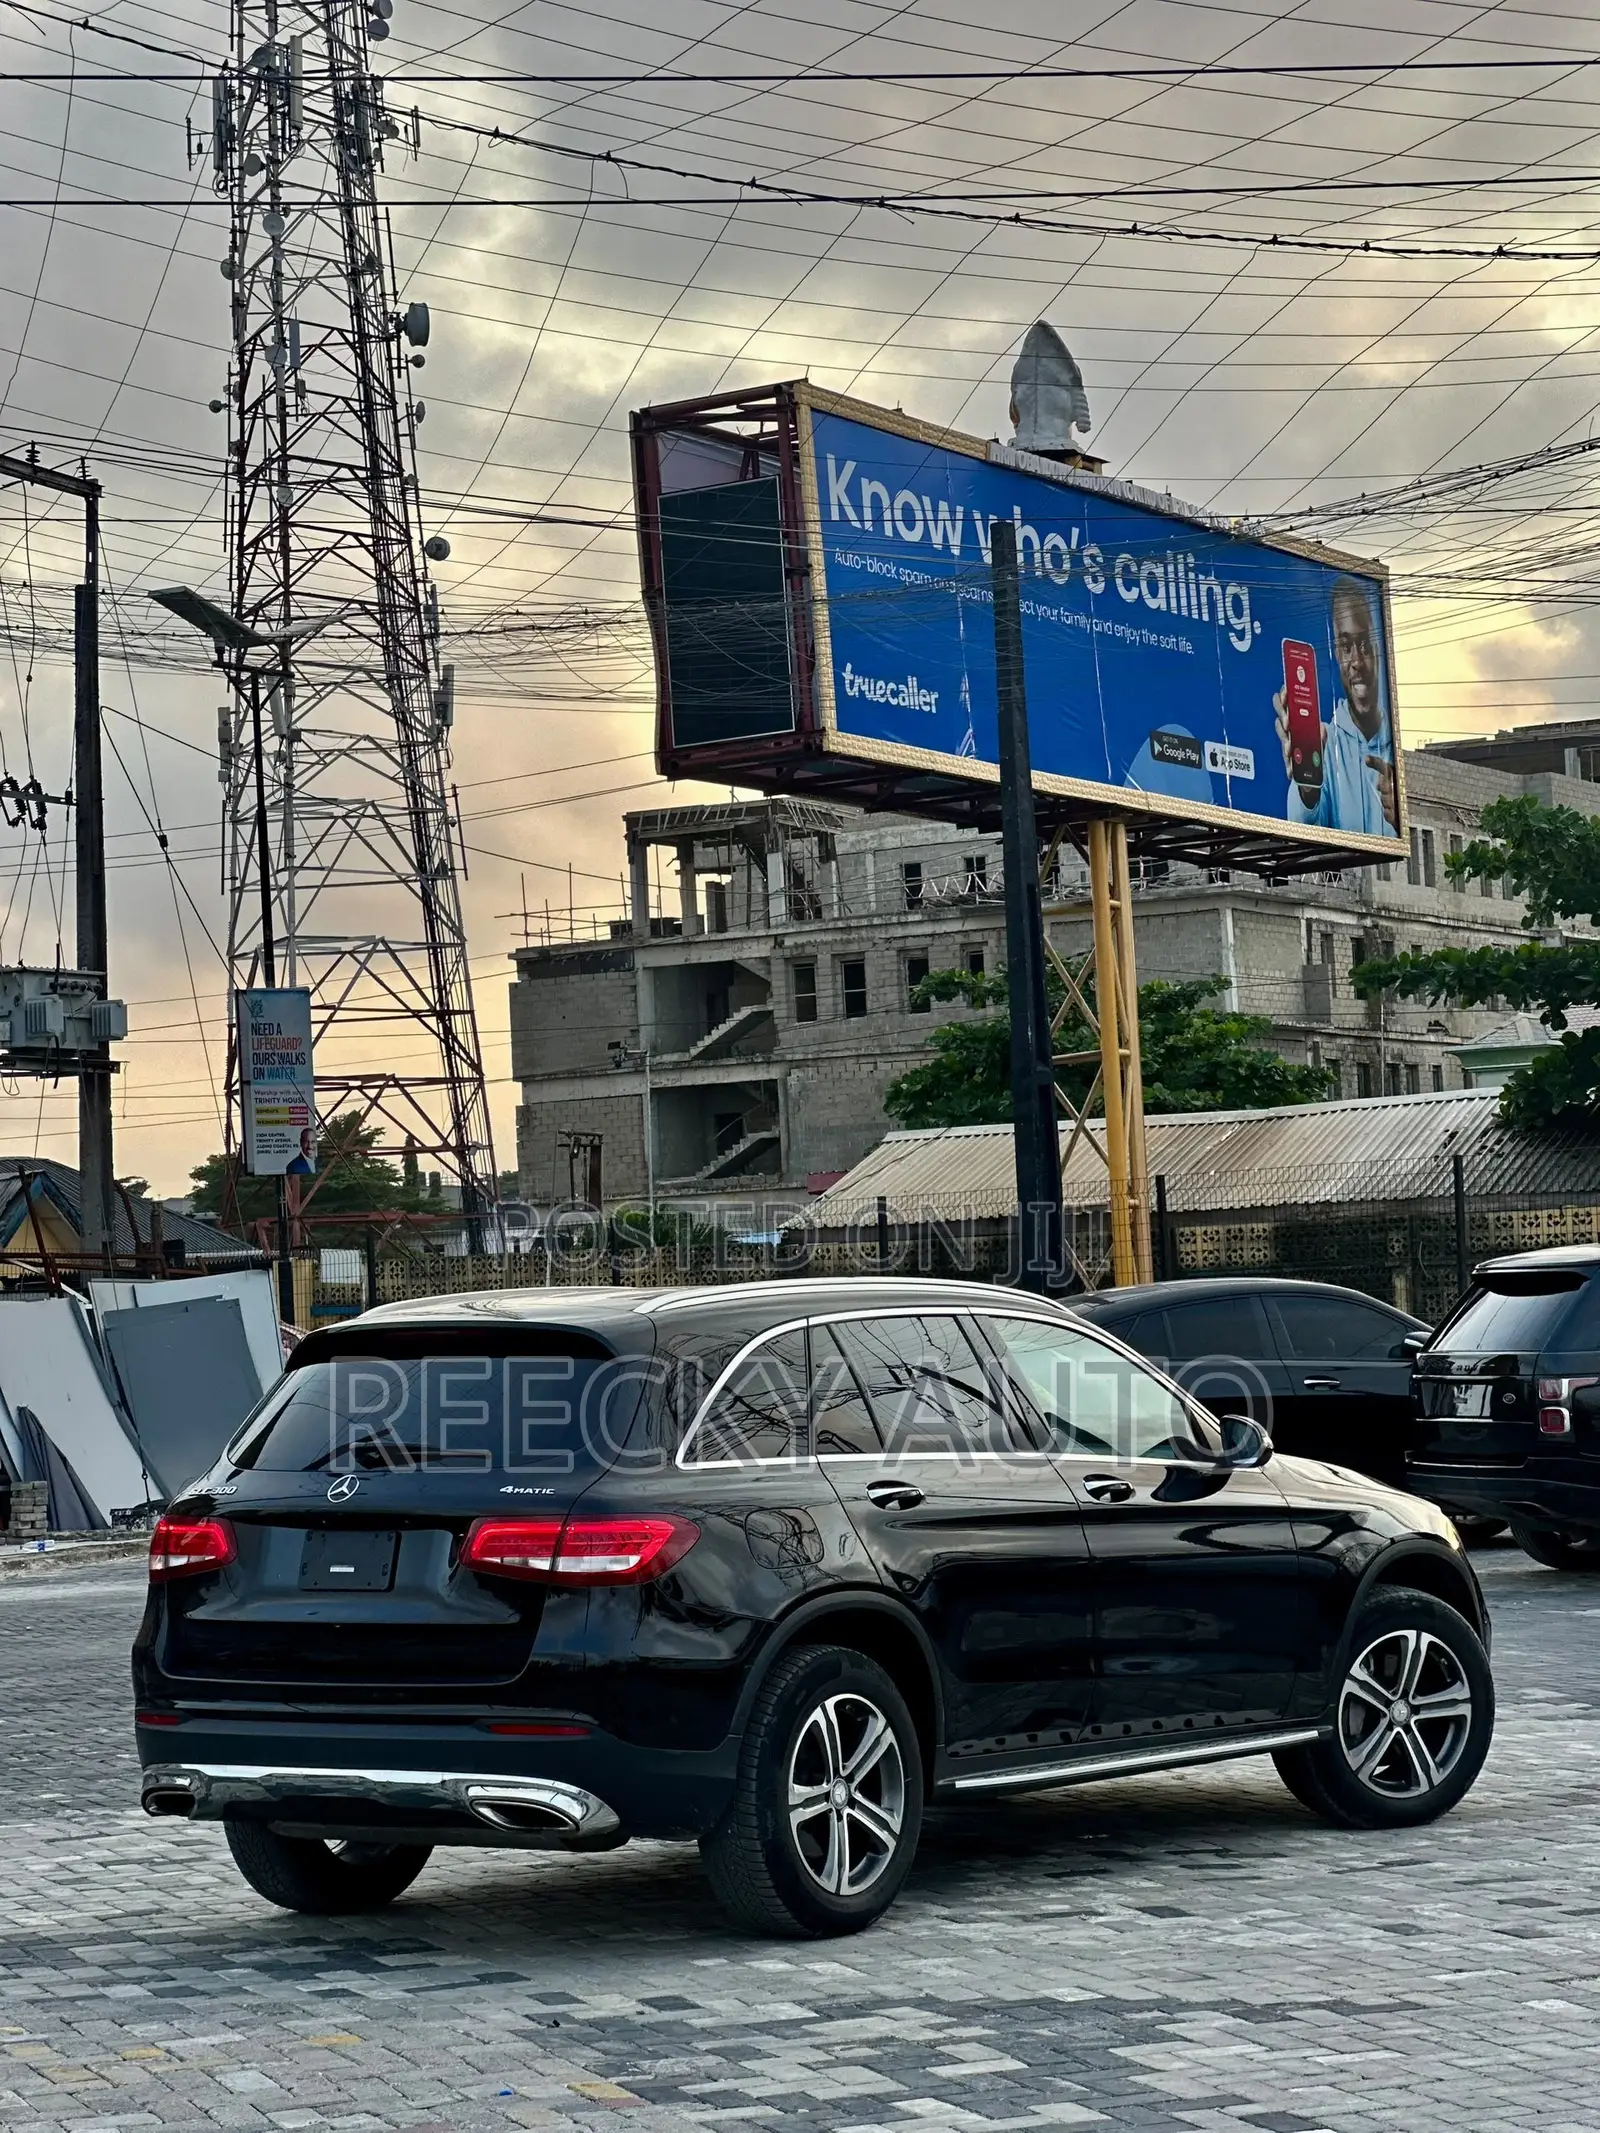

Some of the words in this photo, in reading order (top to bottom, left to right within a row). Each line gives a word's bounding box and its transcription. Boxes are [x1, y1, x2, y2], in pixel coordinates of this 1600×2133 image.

[827, 453, 963, 556] Know
[1115, 551, 1262, 652] calling.
[835, 549, 898, 580] Auto-block
[899, 567, 932, 587] spam
[1035, 603, 1059, 622] your
[1059, 607, 1091, 634] family
[1092, 618, 1113, 635] and
[1114, 623, 1141, 646] enjoy
[1142, 629, 1158, 646] the
[1159, 633, 1177, 650] soft
[1178, 637, 1195, 655] life.
[842, 662, 939, 713] truecaller
[1163, 744, 1186, 760] Google
[1186, 749, 1200, 764] Play
[1234, 759, 1251, 772] Store
[251, 1022, 274, 1036] NEED
[276, 1022, 283, 1036] A
[252, 1036, 302, 1051] LIFEGUARD?
[252, 1052, 276, 1066] OURS
[276, 1051, 306, 1066] WALKS
[253, 1066, 265, 1080] ON
[499, 1485, 556, 1495] 4MATIC
